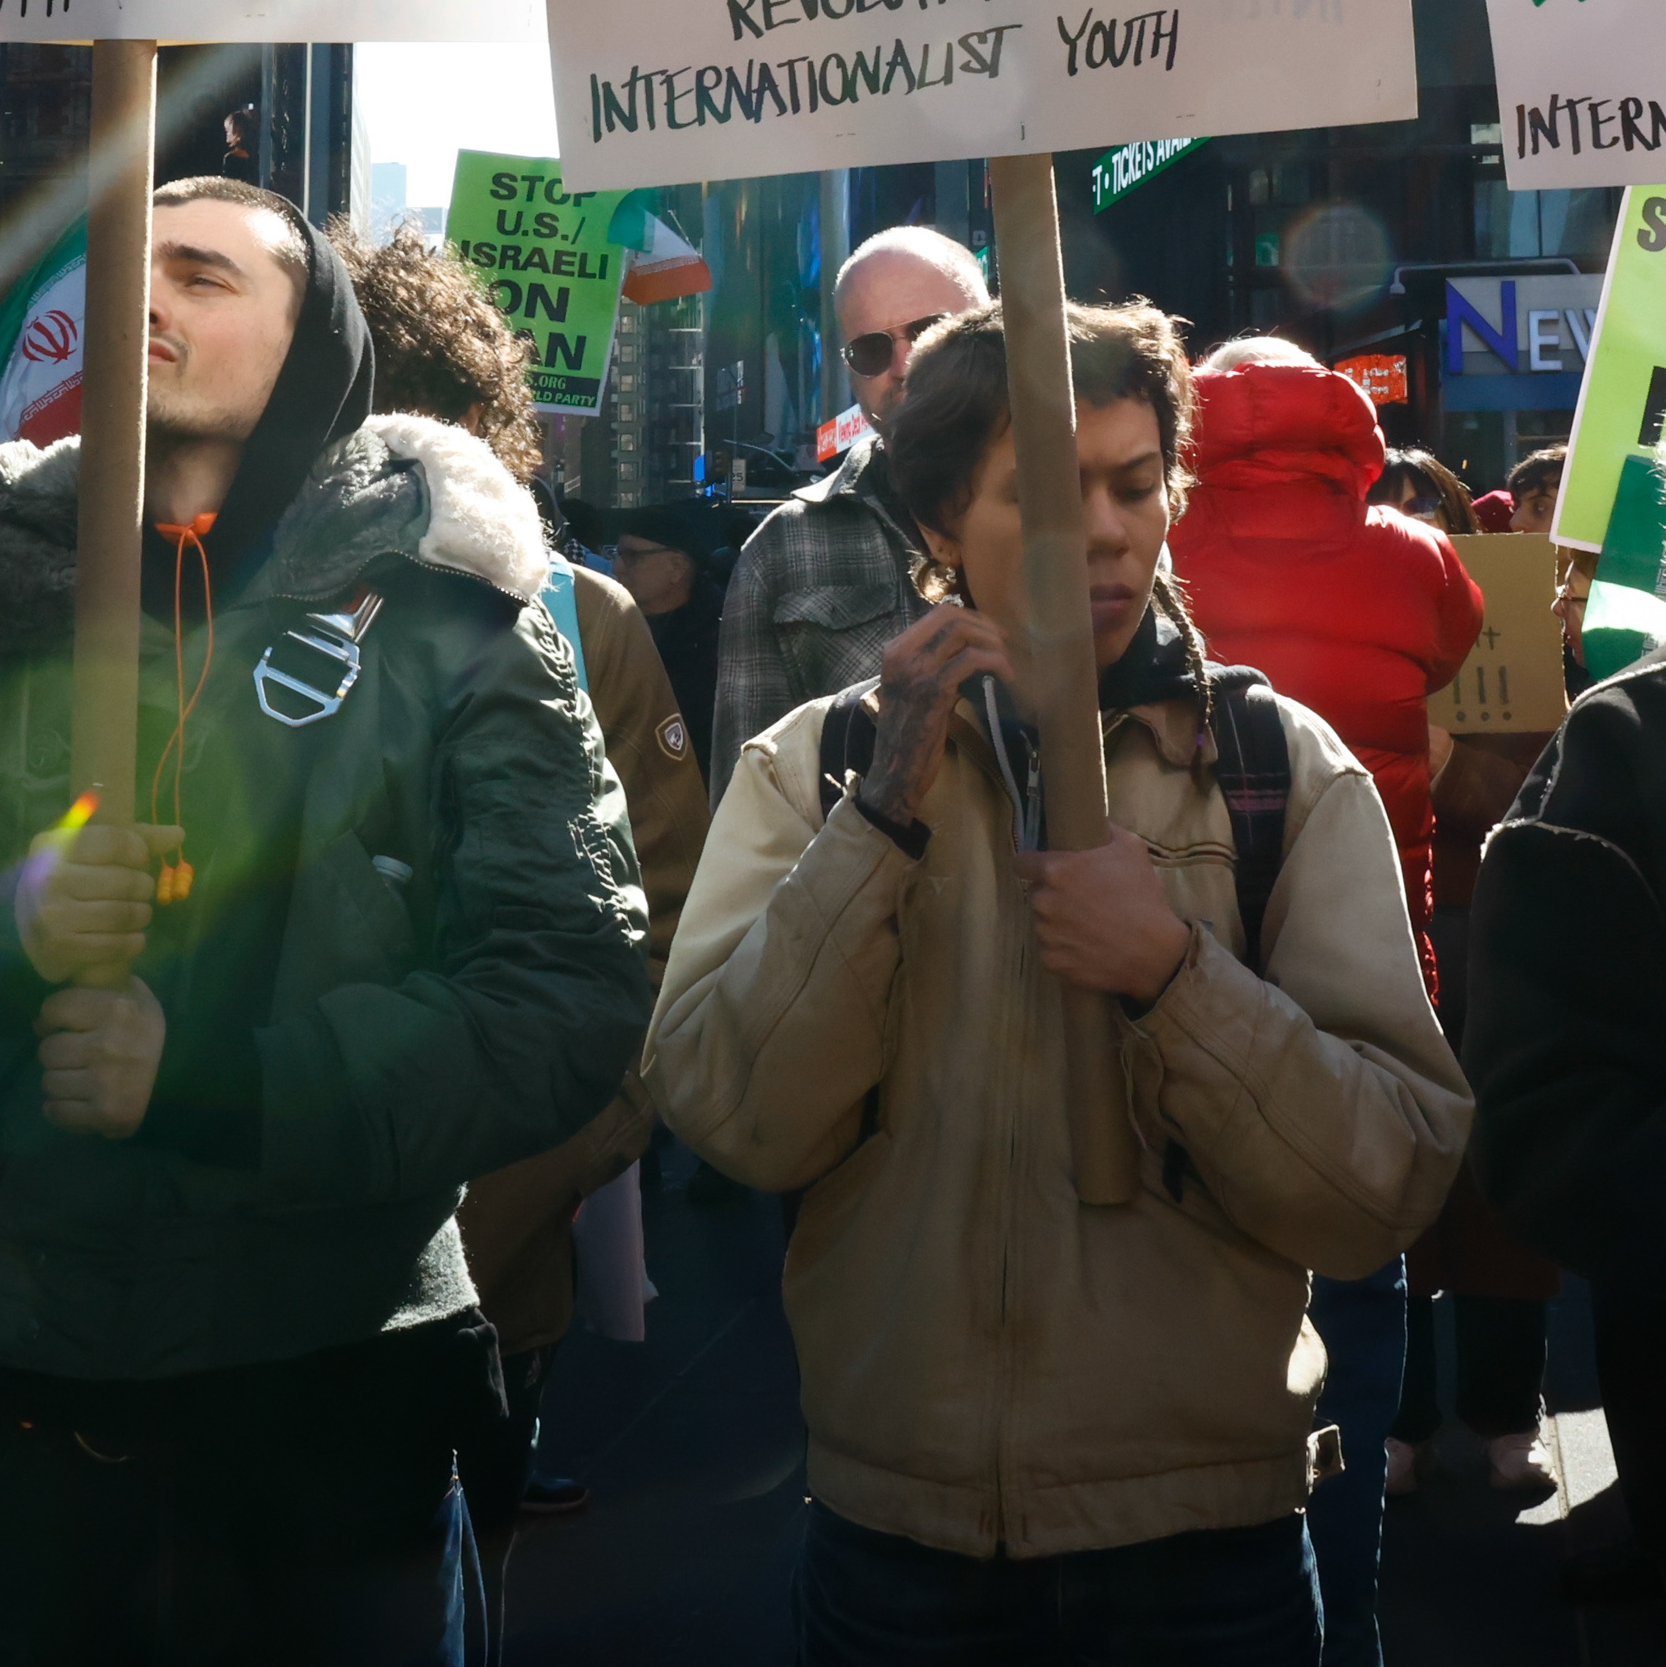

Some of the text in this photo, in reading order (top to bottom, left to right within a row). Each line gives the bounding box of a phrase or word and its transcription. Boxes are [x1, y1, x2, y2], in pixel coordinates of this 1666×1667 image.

[590, 7, 1180, 144] INTERNATIONALIST YOUTH
[1111, 140, 1155, 195] TICKETS
[496, 208, 587, 246] U.S./
[460, 240, 609, 280] ISRAELI
[490, 279, 571, 323] ON
[554, 392, 596, 407] PARTY
